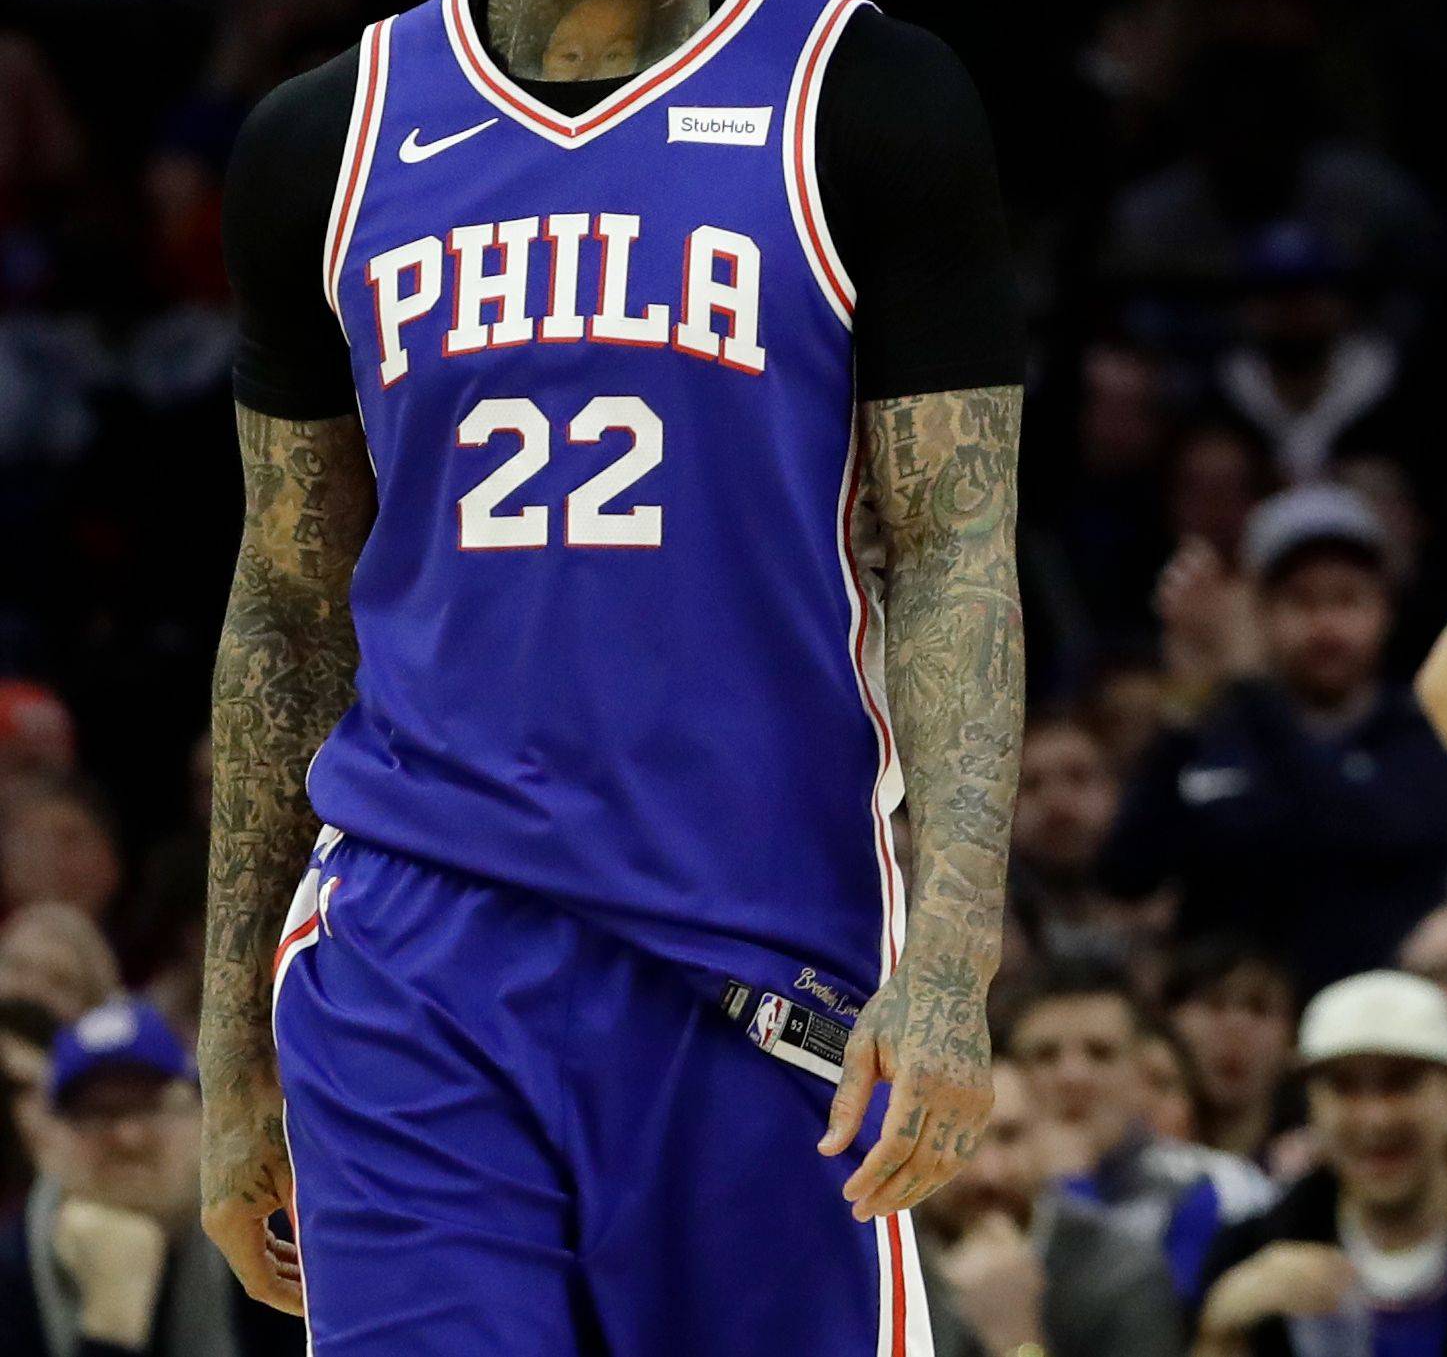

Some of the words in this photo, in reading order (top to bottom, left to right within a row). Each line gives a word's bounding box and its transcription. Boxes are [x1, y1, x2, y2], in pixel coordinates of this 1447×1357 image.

[681, 117, 755, 135] StubHub
[365, 213, 765, 389] PHILA
[456, 396, 663, 550] 22
